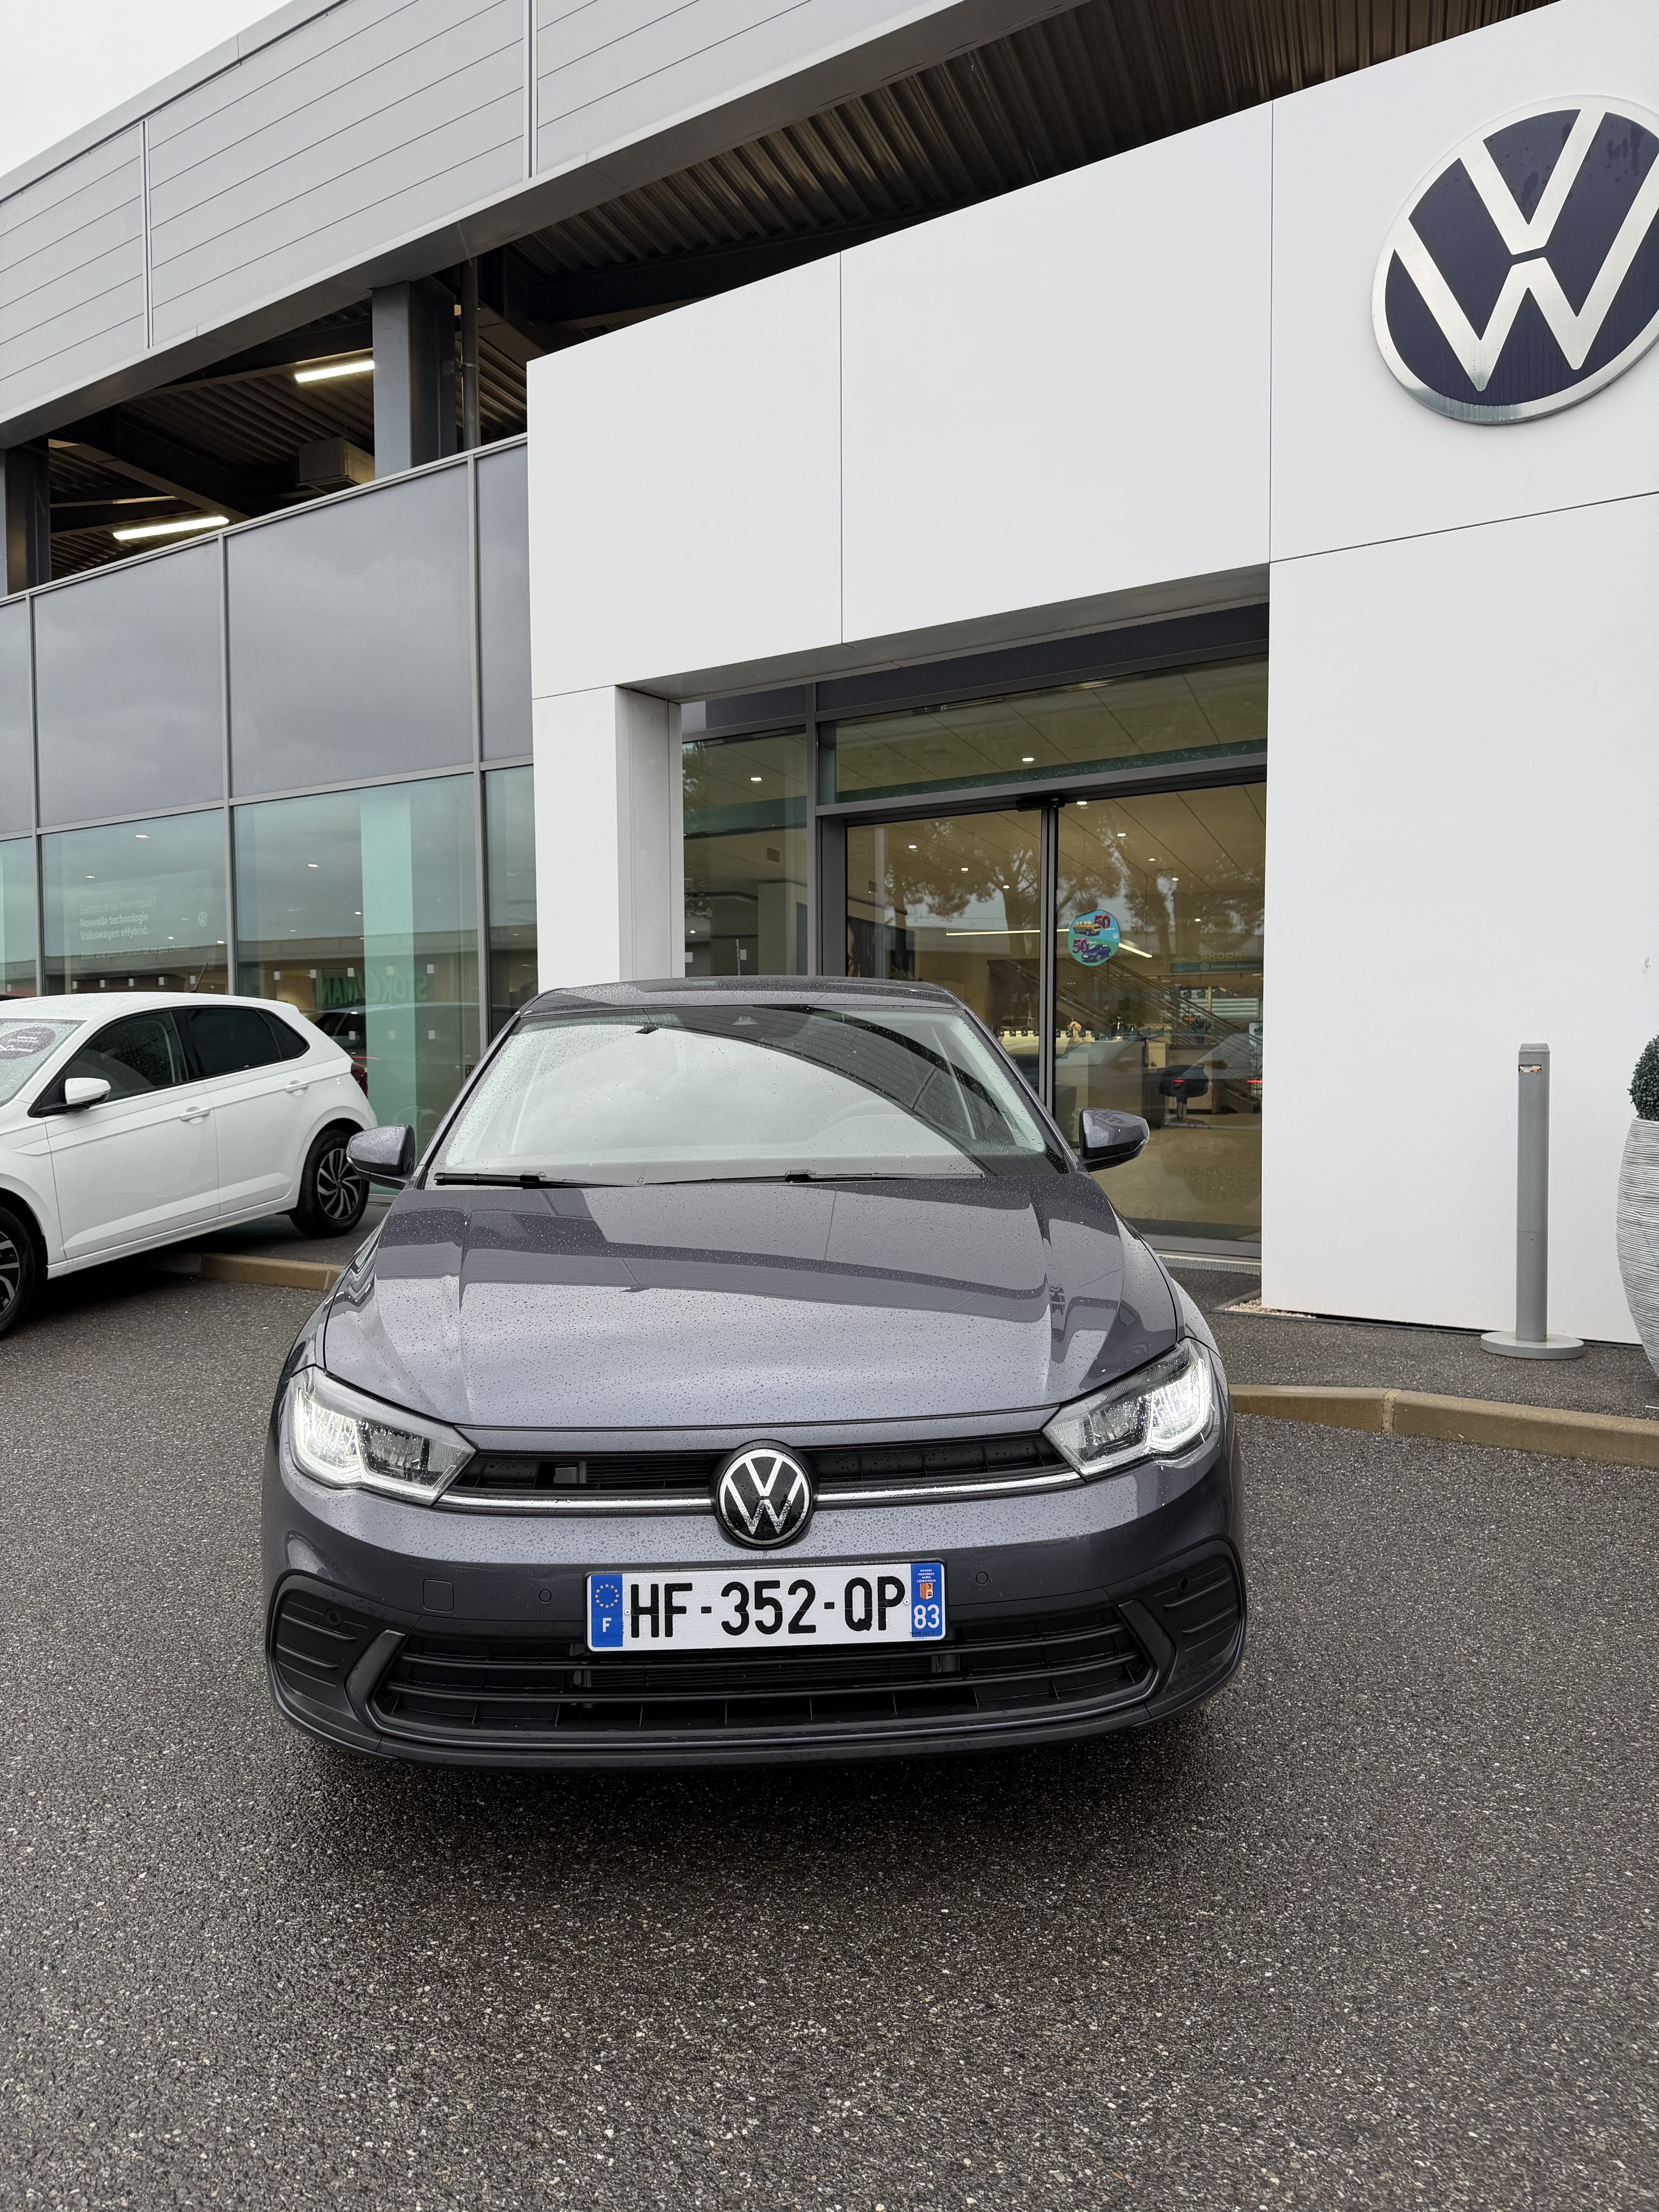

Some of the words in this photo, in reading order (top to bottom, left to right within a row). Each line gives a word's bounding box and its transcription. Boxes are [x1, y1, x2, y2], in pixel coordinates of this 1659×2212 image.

[80, 916, 108, 927] Nouvelle
[110, 911, 149, 925] technologie
[1094, 914, 1110, 929] 50
[80, 929, 120, 941] Volkswagen
[120, 924, 149, 939] eHybrid.
[1072, 938, 1089, 953] 50
[630, 1575, 905, 1638] HF-352-QP
[914, 1604, 939, 1629] 83
[602, 1617, 612, 1633] F
